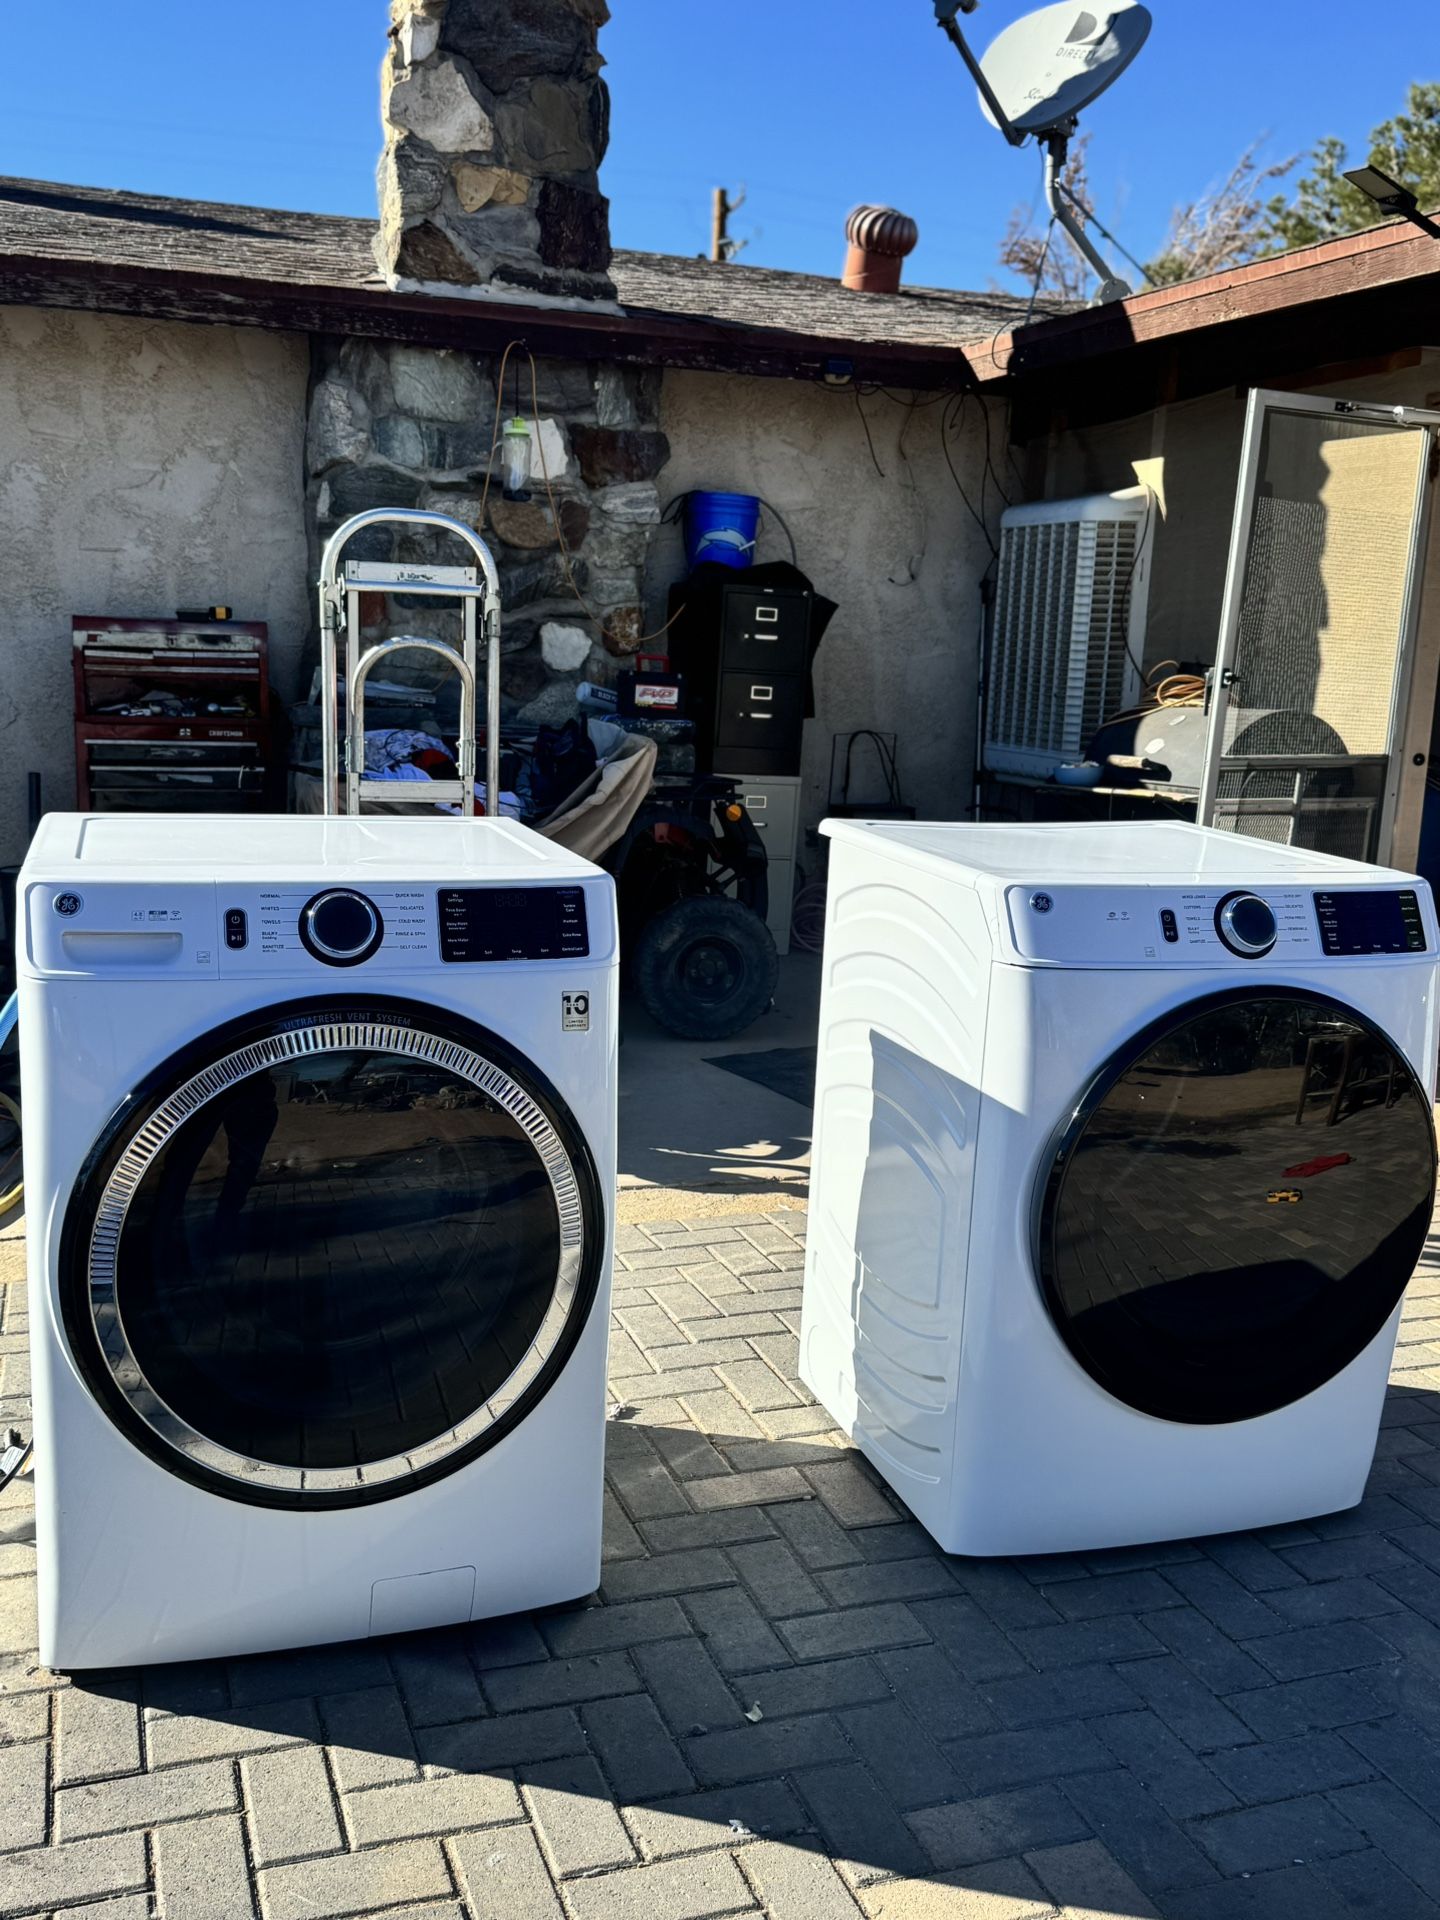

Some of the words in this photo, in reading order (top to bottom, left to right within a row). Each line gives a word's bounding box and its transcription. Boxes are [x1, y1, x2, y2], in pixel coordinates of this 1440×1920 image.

[562, 995, 589, 1015] 10
[283, 1012, 343, 1030] ULTRAFRESH
[346, 1012, 371, 1022] VENT
[376, 1013, 411, 1027] SYSTEM
